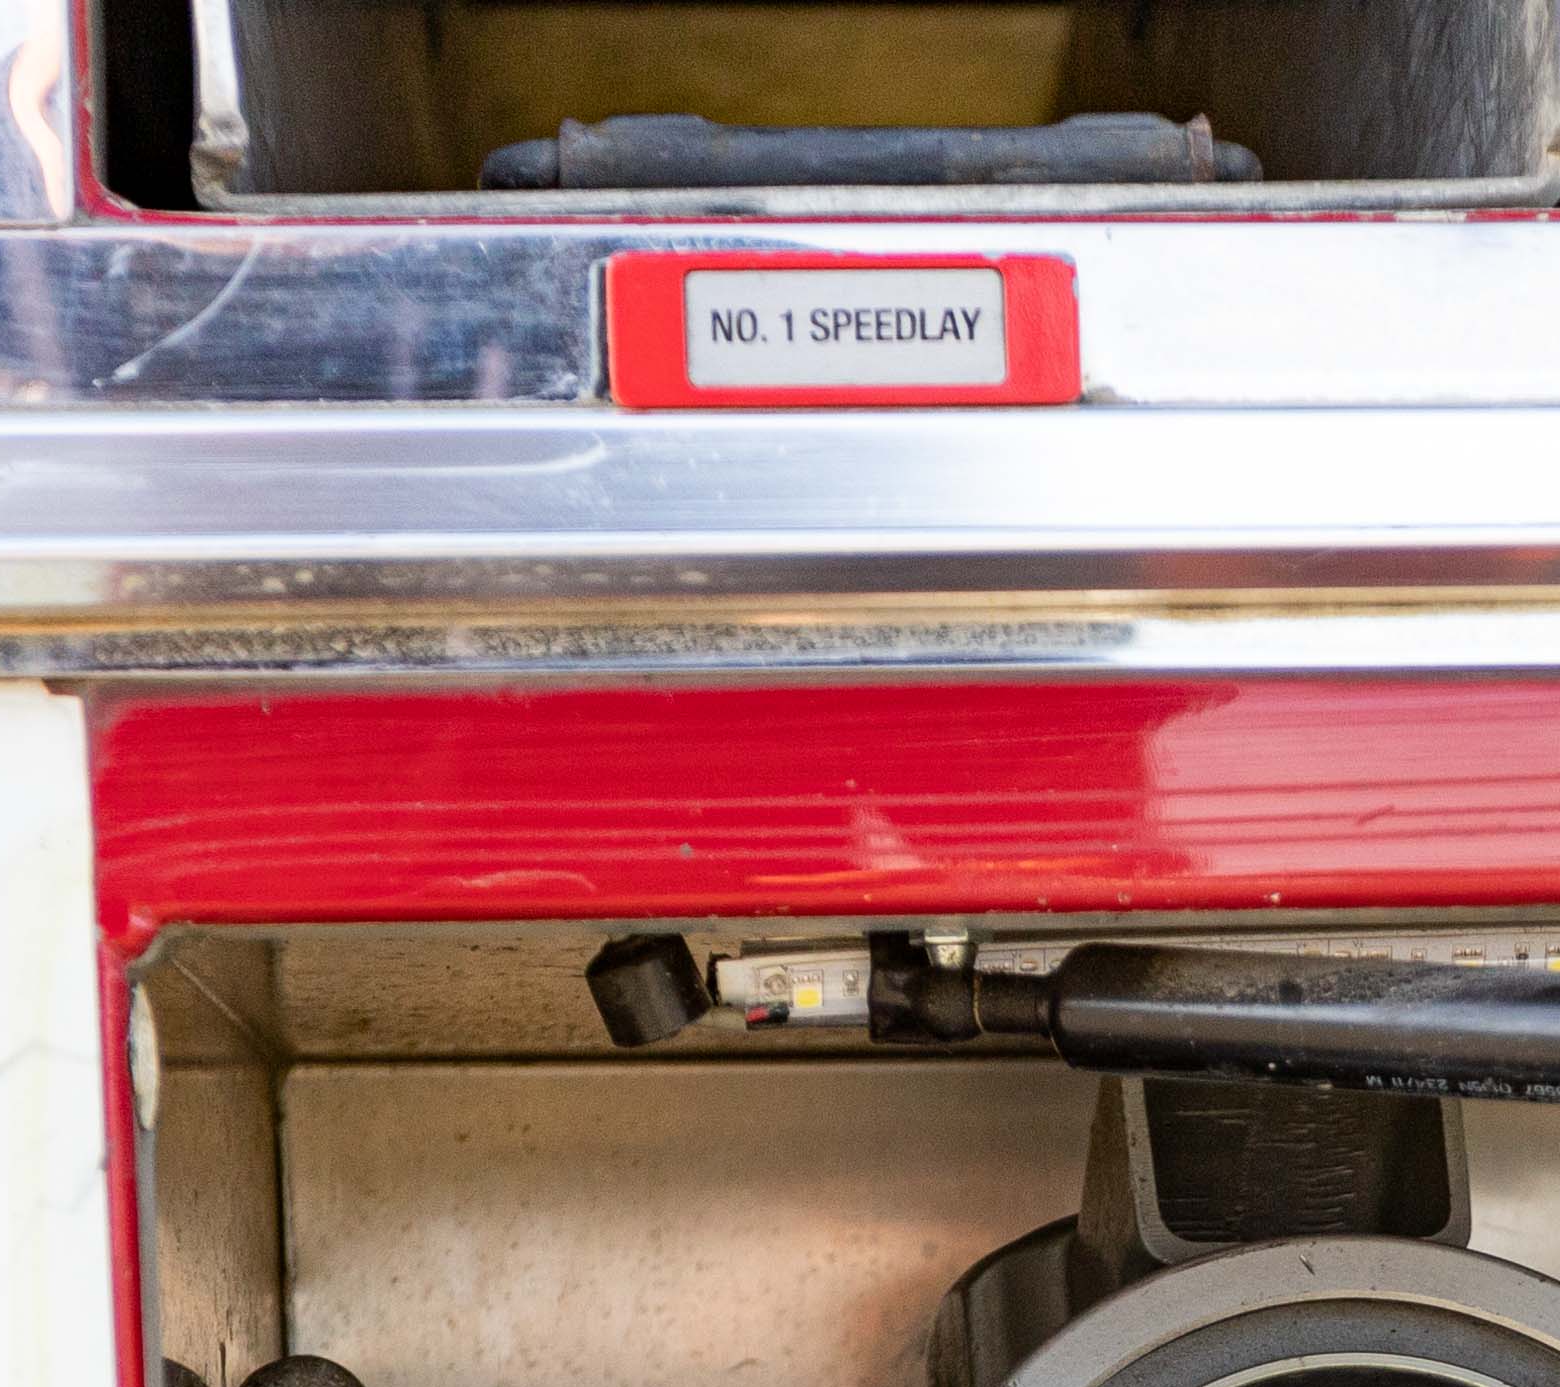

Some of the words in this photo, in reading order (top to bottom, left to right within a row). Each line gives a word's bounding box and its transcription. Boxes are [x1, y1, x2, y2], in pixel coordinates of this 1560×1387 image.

[711, 308, 767, 343] NO.
[781, 309, 795, 343] 1
[809, 306, 981, 343] SPEEDLAY
